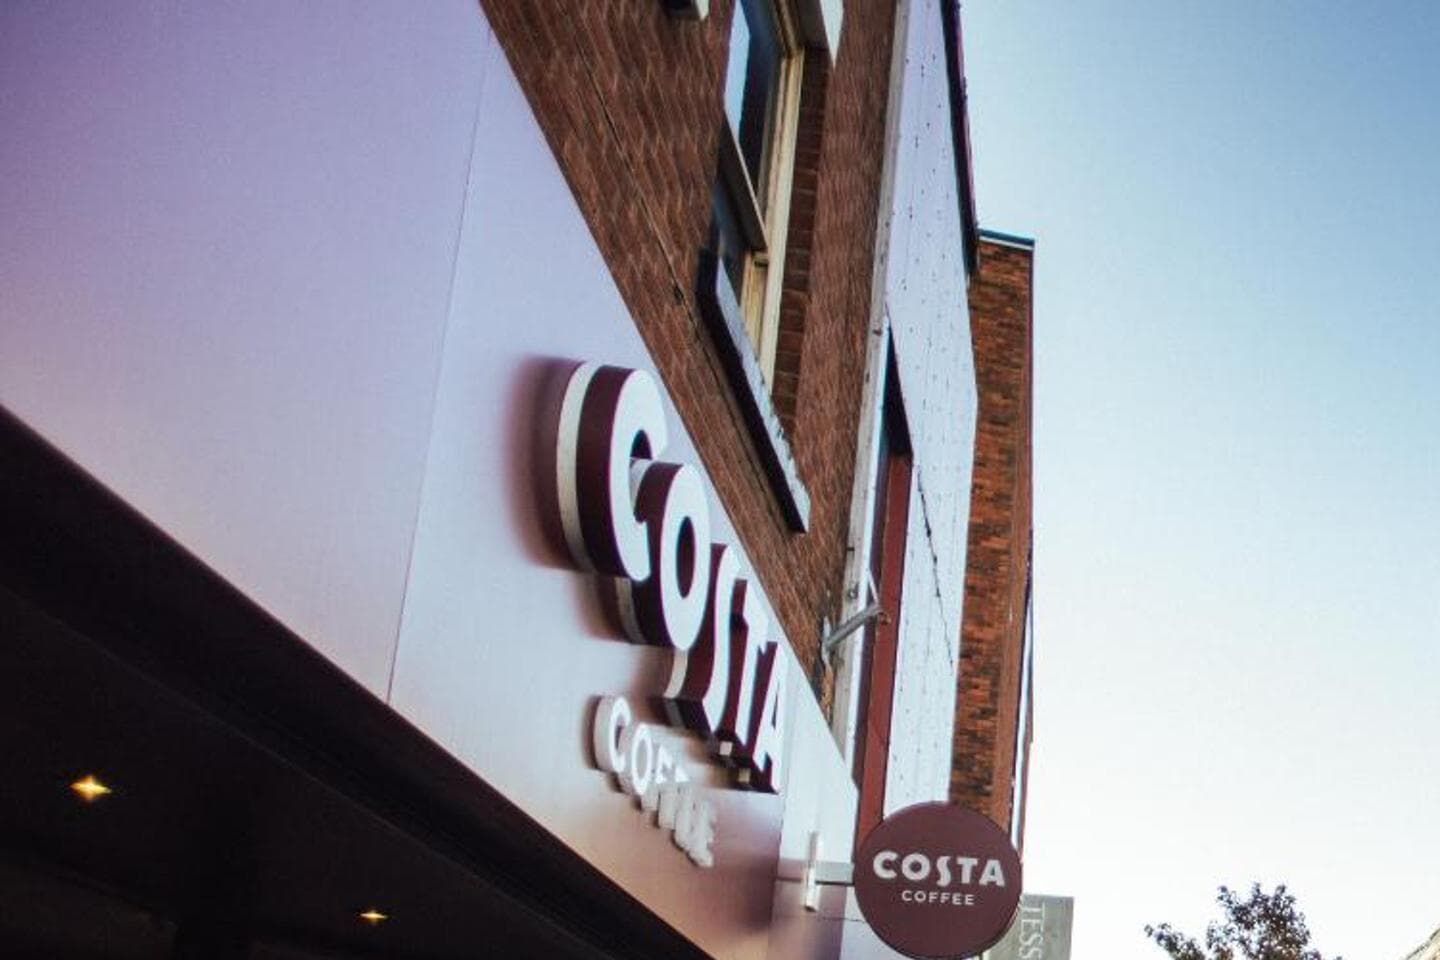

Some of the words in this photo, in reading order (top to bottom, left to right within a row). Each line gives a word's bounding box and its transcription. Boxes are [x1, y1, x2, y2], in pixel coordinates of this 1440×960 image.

[578, 364, 788, 796] COSTA
[873, 850, 1006, 887] COSTA
[902, 890, 975, 906] COFFEE
